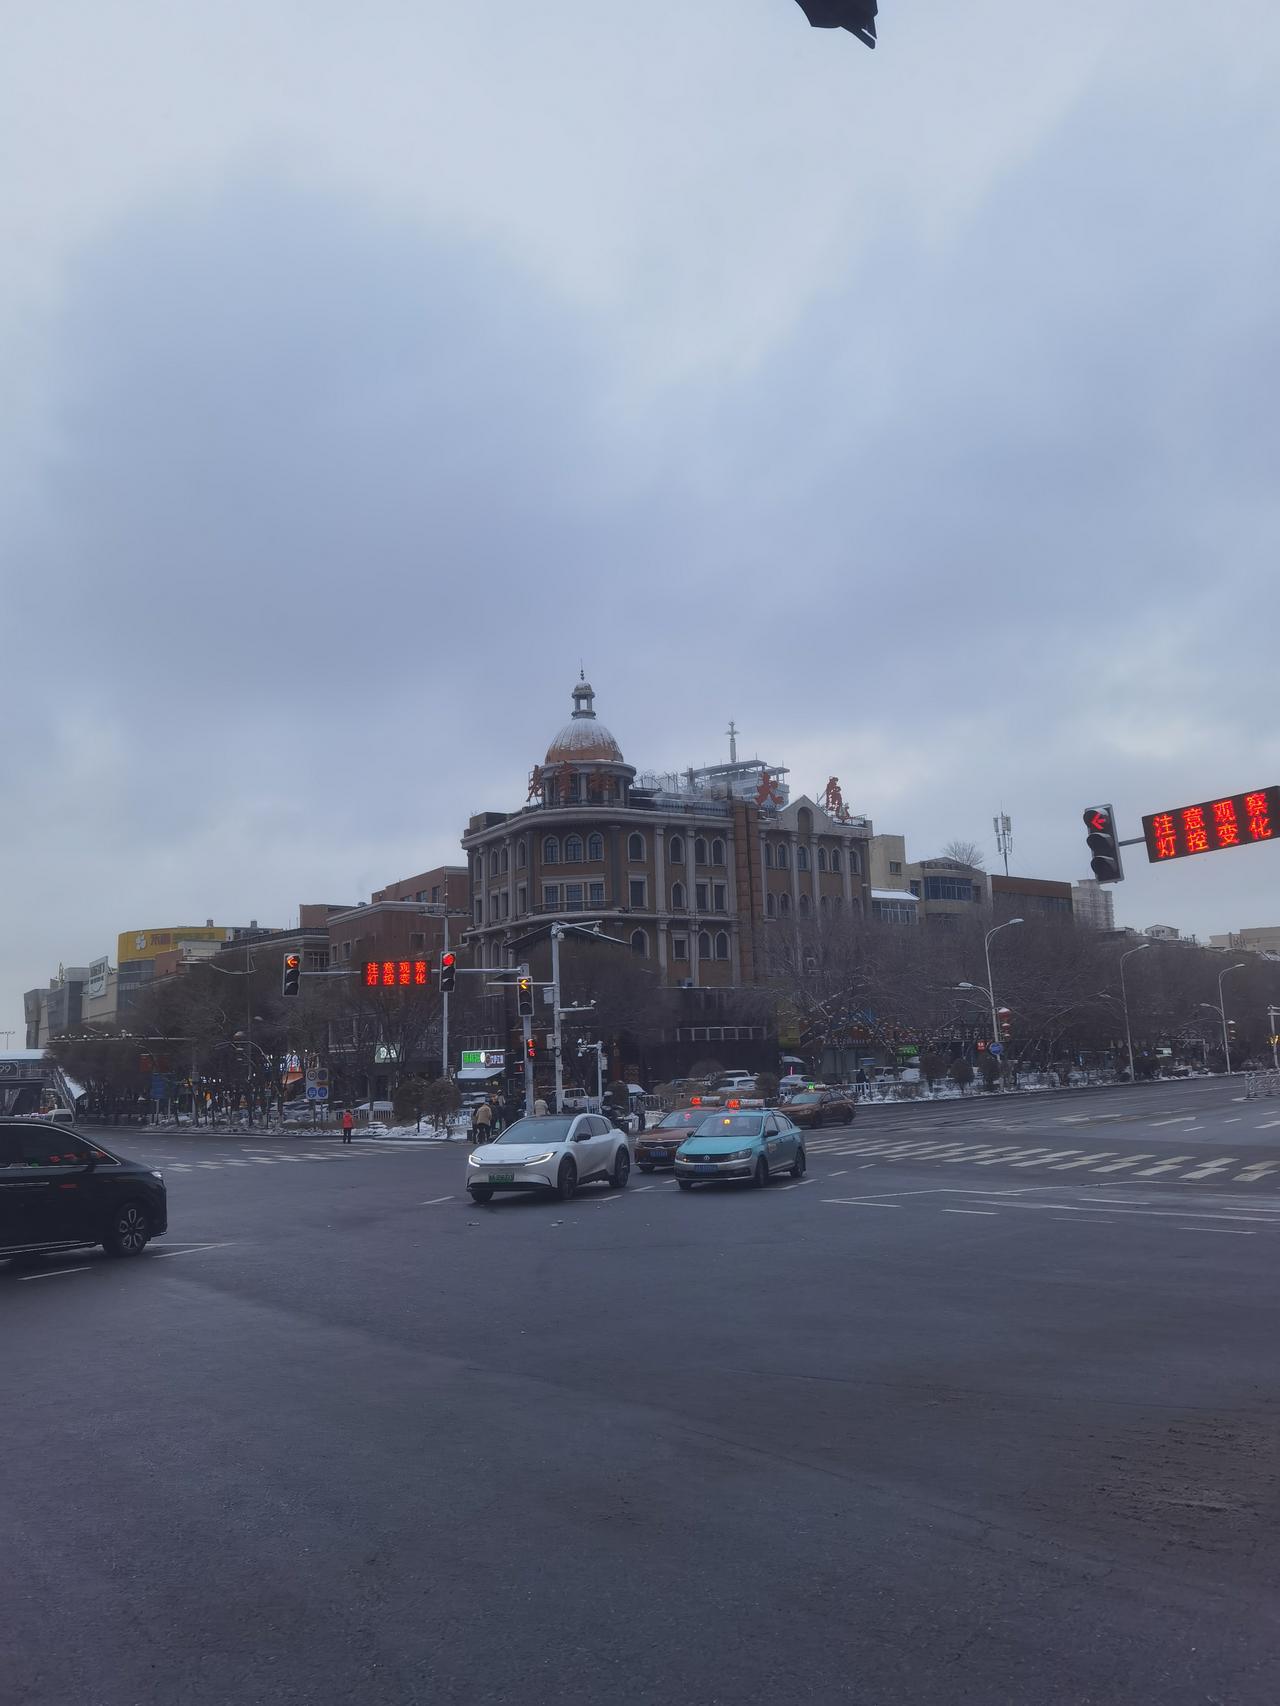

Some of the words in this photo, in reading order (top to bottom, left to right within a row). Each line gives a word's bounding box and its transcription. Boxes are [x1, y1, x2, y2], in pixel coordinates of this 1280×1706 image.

[1153, 792, 1268, 838] 注意观察
[1156, 815, 1272, 858] 灯控变化
[367, 961, 426, 974] 注意观察
[367, 973, 426, 986] 灯控变化
